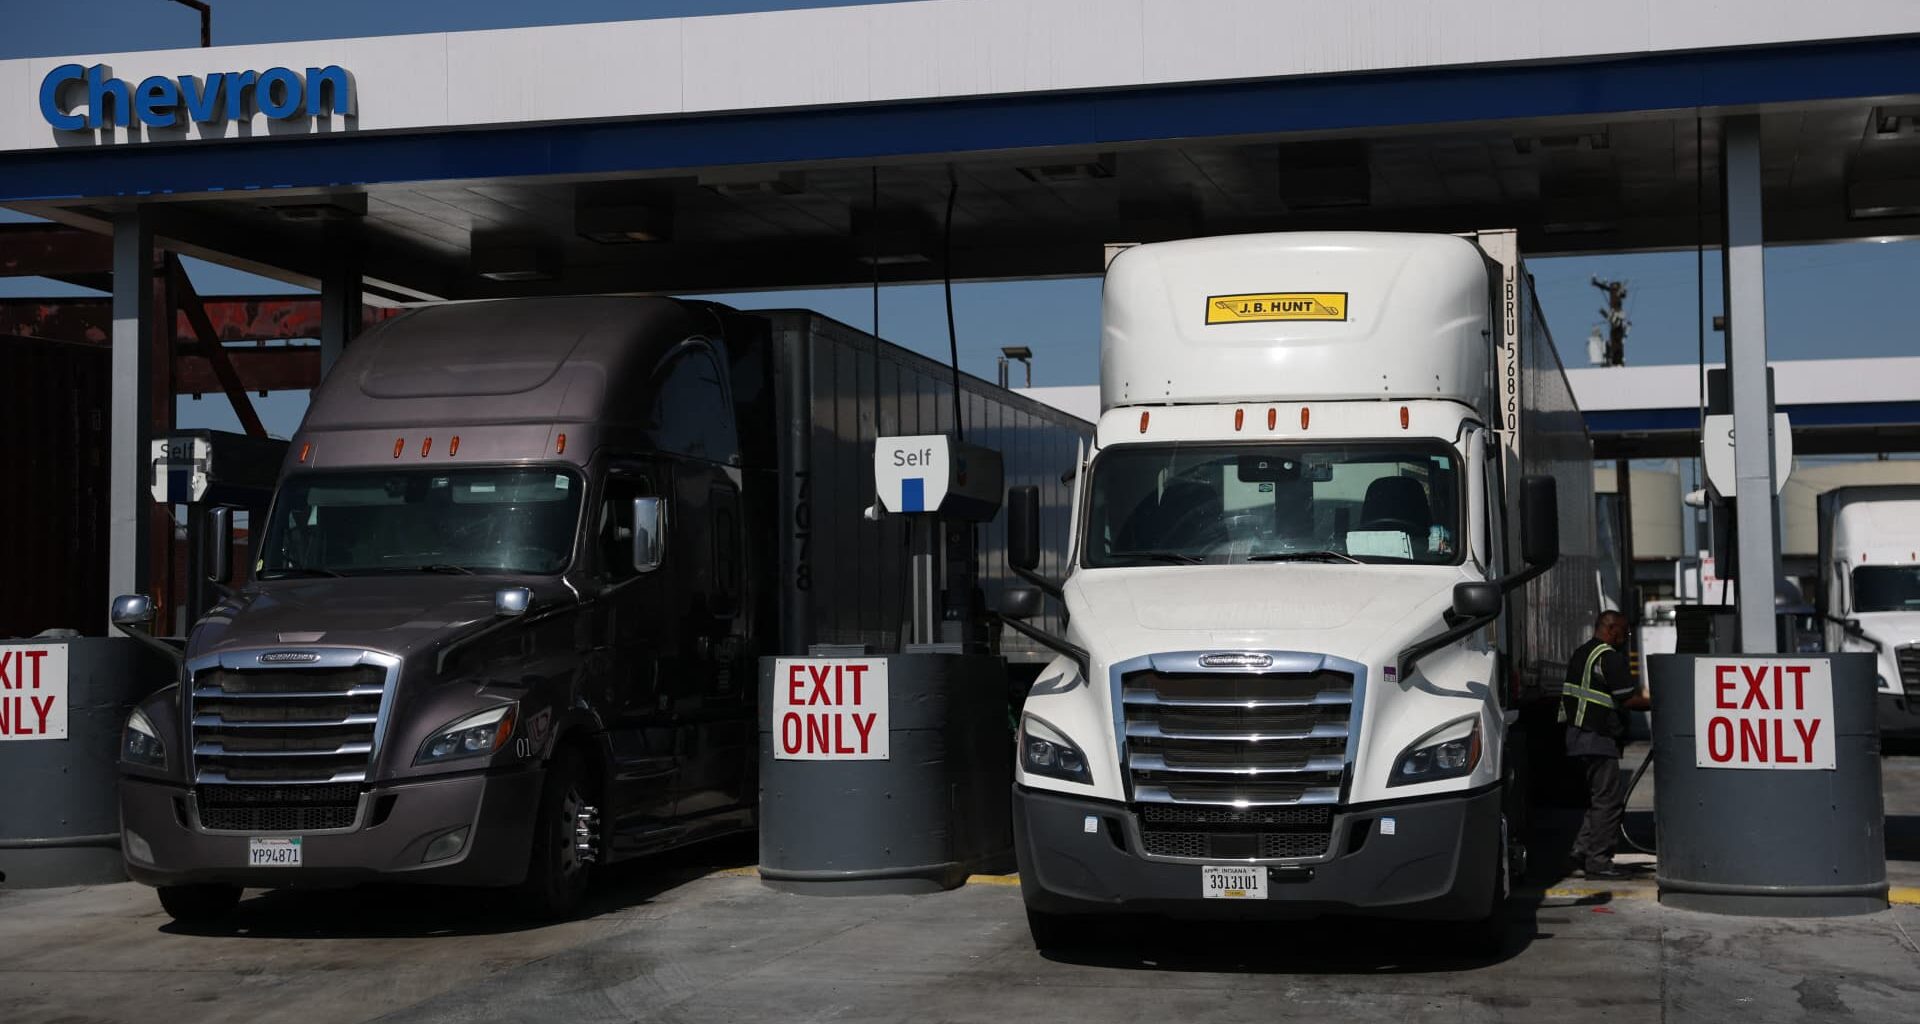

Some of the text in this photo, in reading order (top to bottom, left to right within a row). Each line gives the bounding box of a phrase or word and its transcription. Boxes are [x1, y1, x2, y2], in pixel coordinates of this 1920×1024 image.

[39, 63, 349, 131] Chevron
[1270, 301, 1313, 312] HUNT
[1506, 265, 1516, 448] JBRU 568607
[893, 448, 932, 467] Self
[795, 471, 812, 591] 7078
[789, 664, 869, 706] EXIT
[1715, 664, 1811, 711] EXIT
[516, 737, 532, 758] 01
[782, 711, 877, 754] ONLY
[1707, 716, 1821, 763] ONLY
[252, 848, 299, 864] YP94871
[1210, 874, 1259, 890] 3313101
